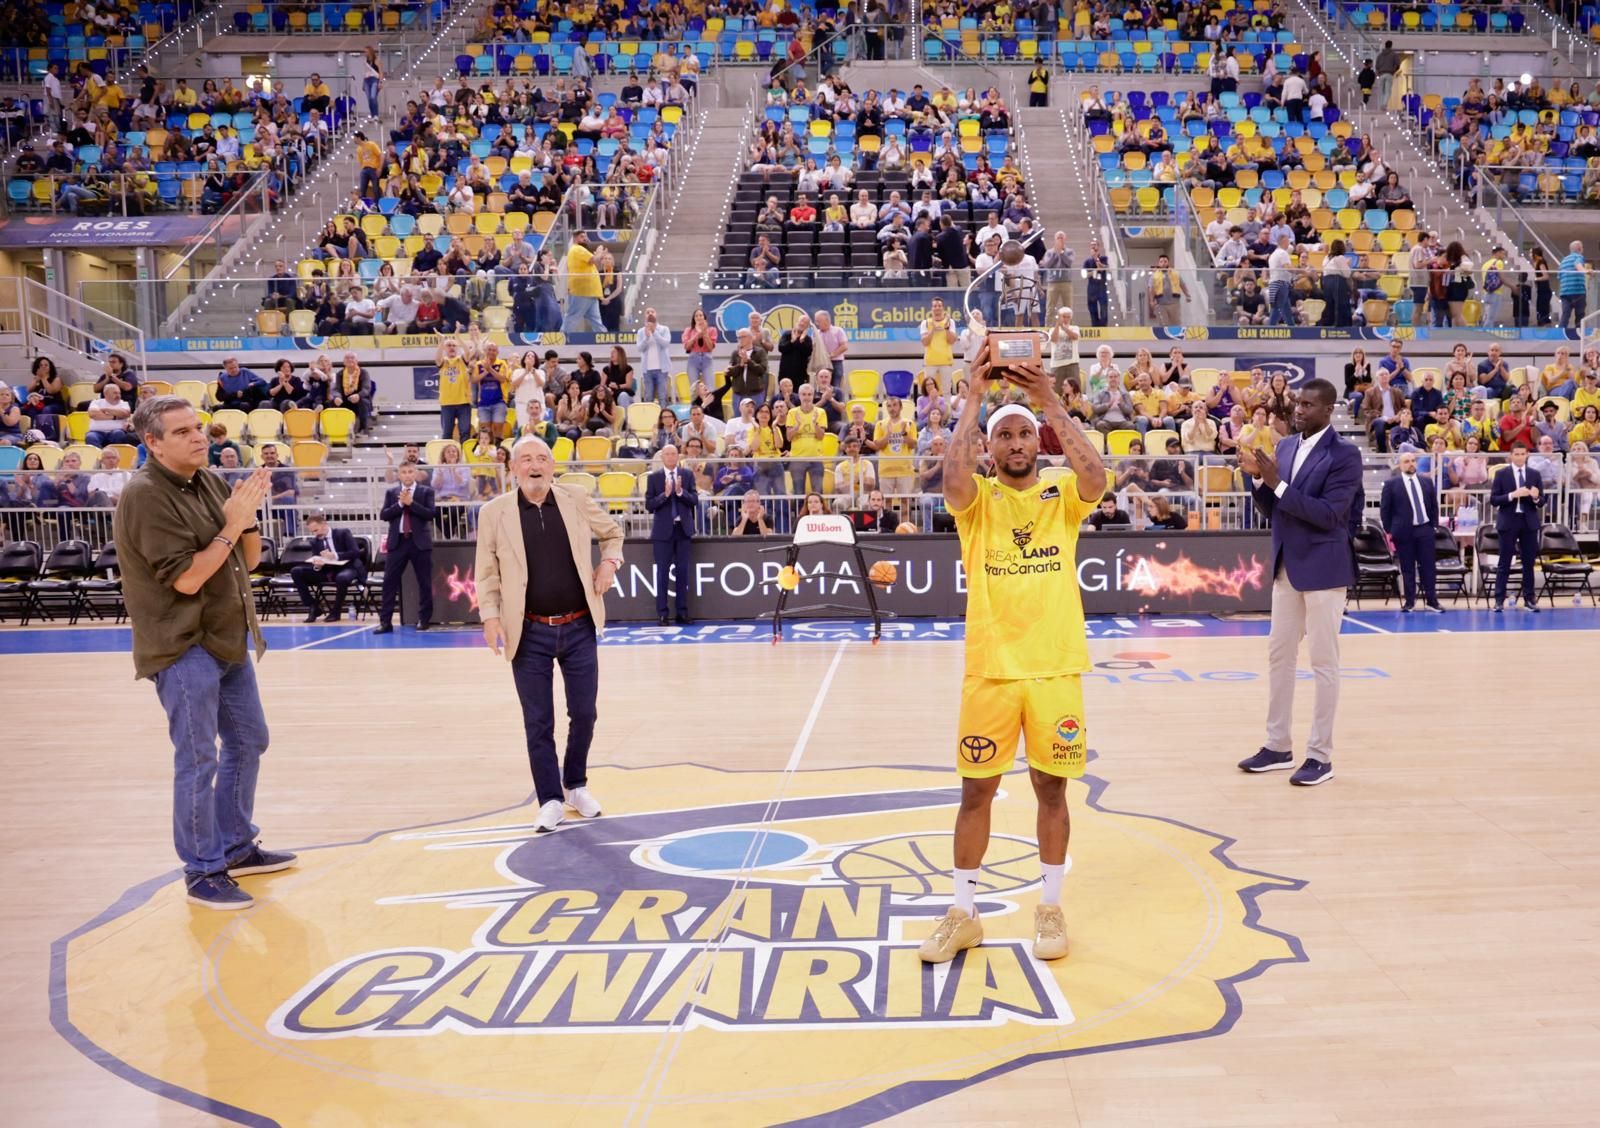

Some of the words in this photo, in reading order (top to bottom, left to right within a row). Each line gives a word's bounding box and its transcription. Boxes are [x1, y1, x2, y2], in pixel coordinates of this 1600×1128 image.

[72, 221, 151, 231] ROES
[1237, 328, 1257, 338] GRAN
[1260, 328, 1291, 338] CANARIA
[401, 336, 421, 346] GRAN
[595, 333, 615, 344] GRAN
[806, 523, 842, 533] Wilson
[1007, 560, 1061, 576] Canaria
[610, 560, 861, 597] ANSFORMA
[597, 624, 757, 636] ran
[600, 633, 706, 643] RAN
[1053, 751, 1067, 760] del
[490, 886, 888, 944] GRAN
[288, 944, 1052, 1030] CANARIA
